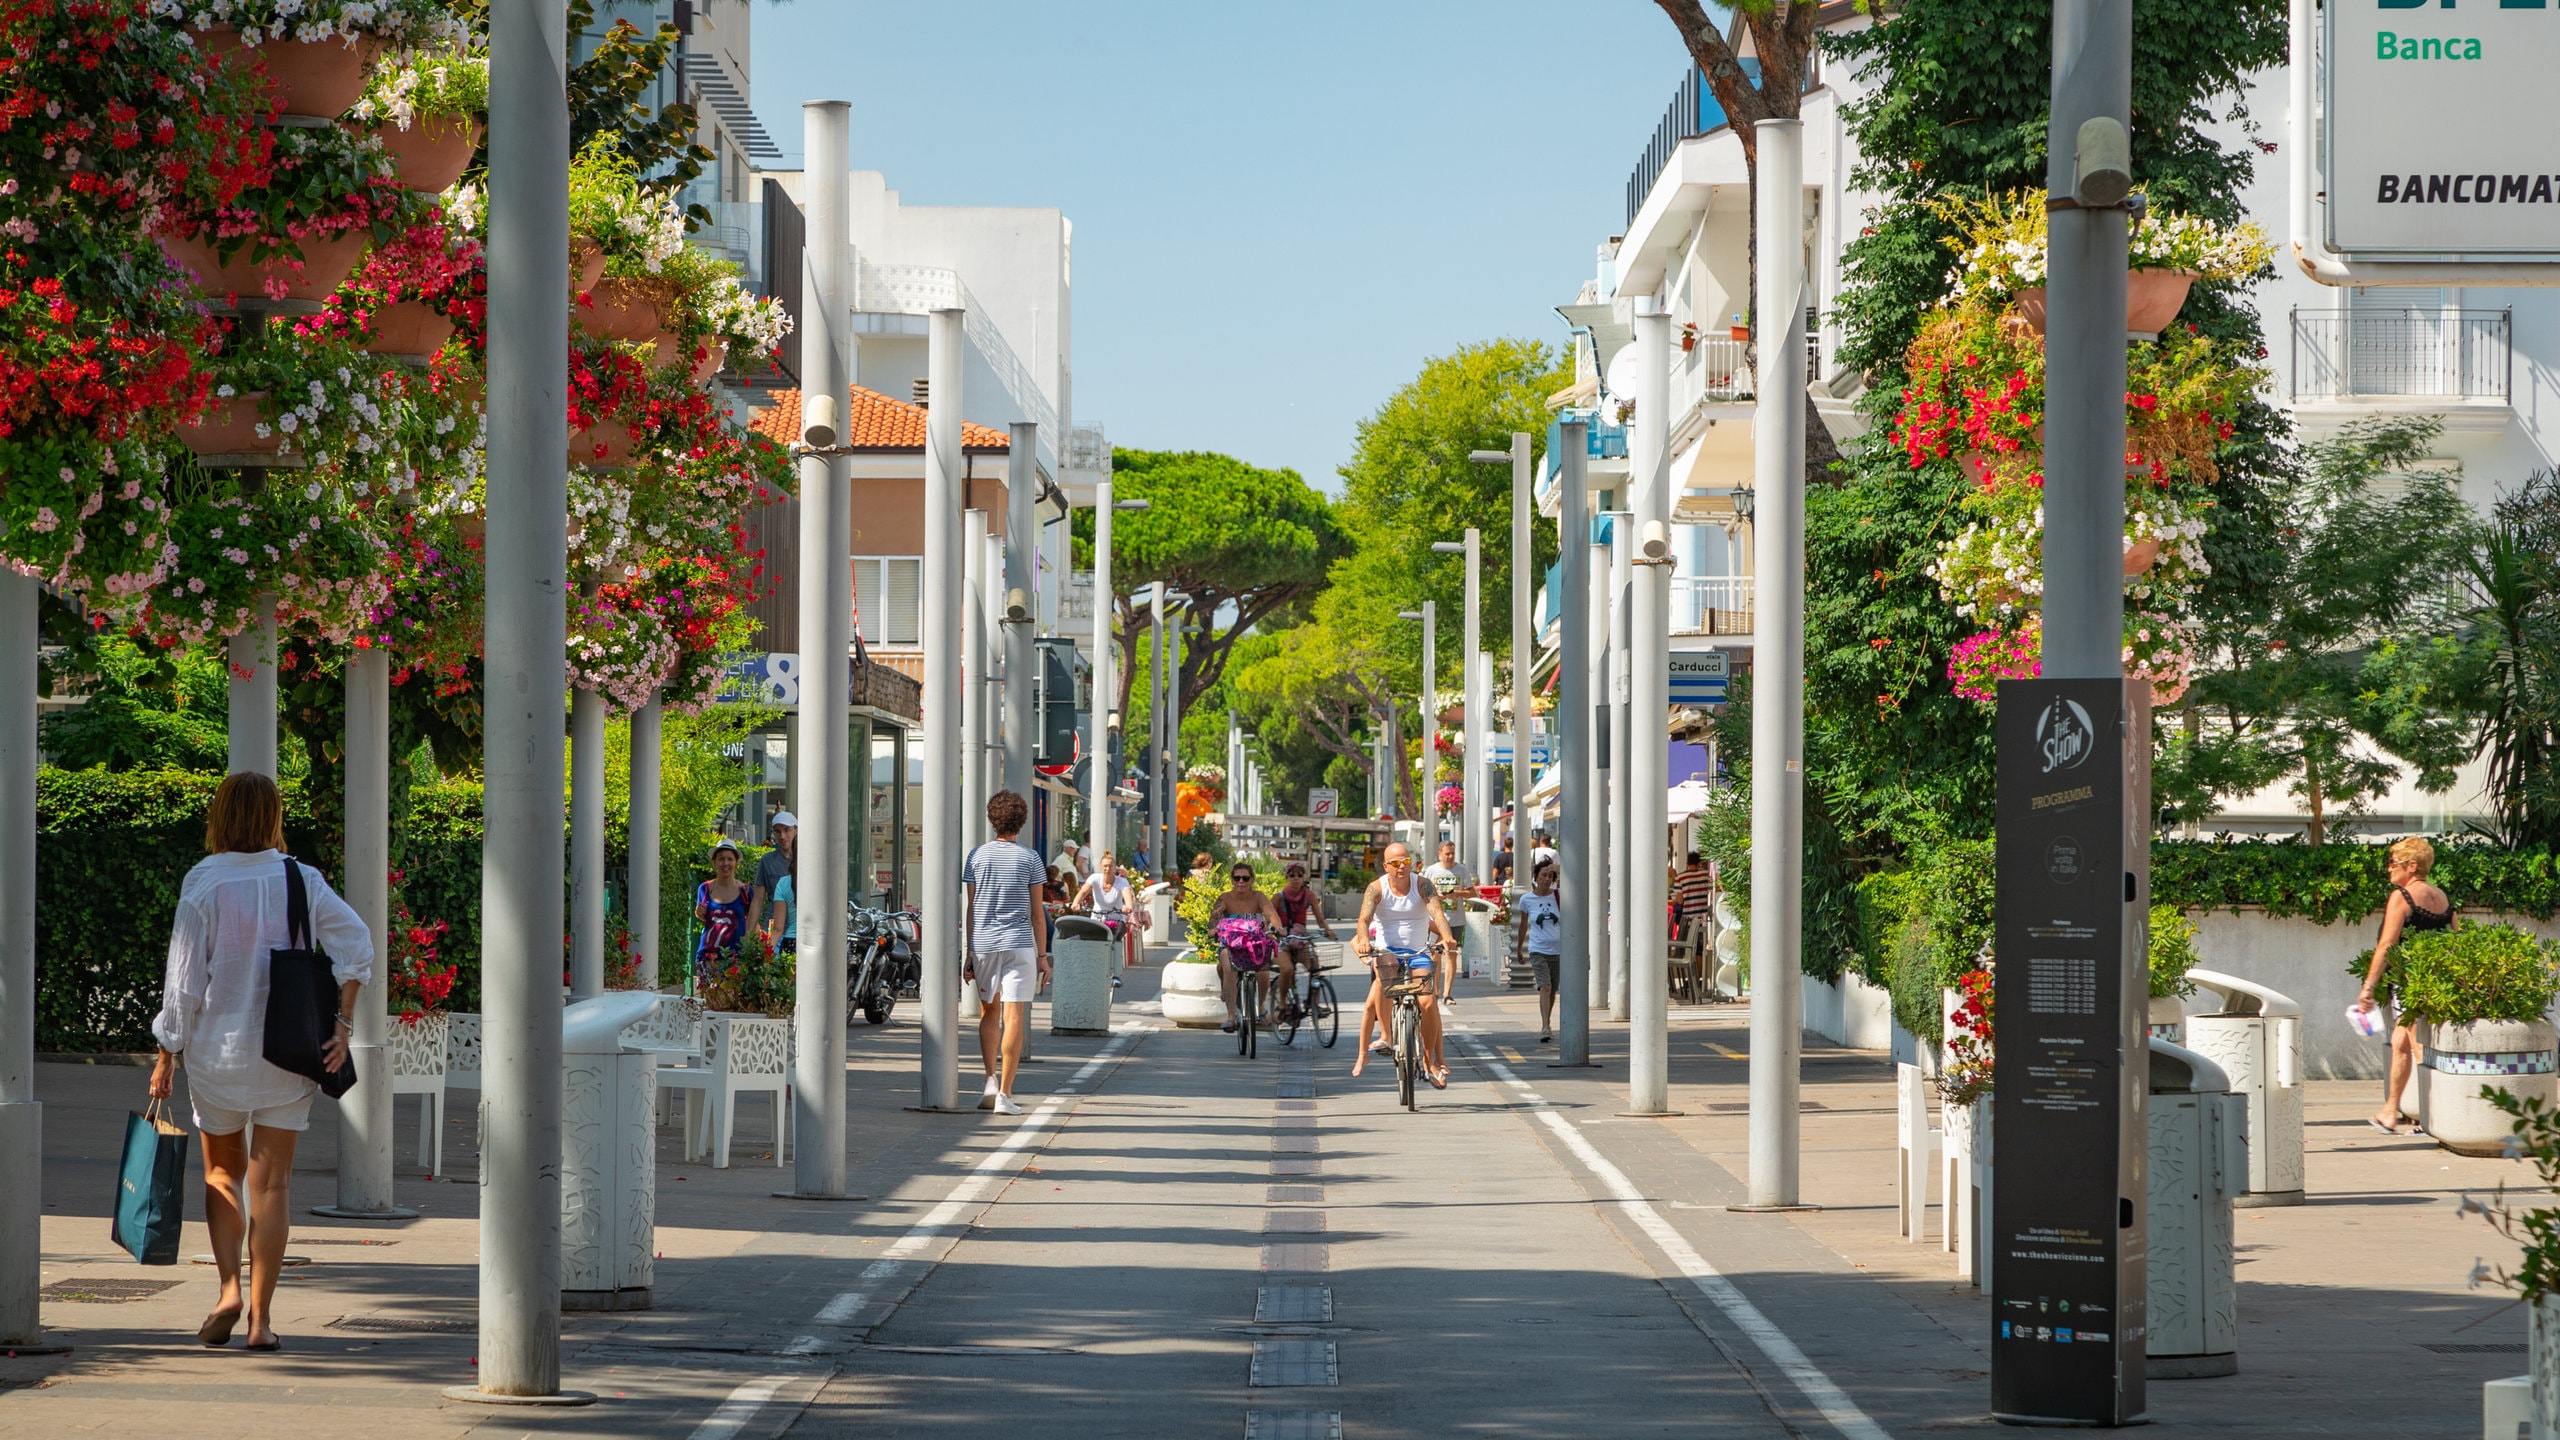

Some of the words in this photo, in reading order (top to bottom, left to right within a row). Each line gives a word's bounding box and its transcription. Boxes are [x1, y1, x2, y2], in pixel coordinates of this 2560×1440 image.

[2377, 31, 2482, 60] Banca
[1669, 662, 1722, 672] Carducci
[2054, 716, 2071, 738] THE
[2042, 727, 2083, 774] SHOW
[2031, 785, 2094, 810] PROGRAMMA
